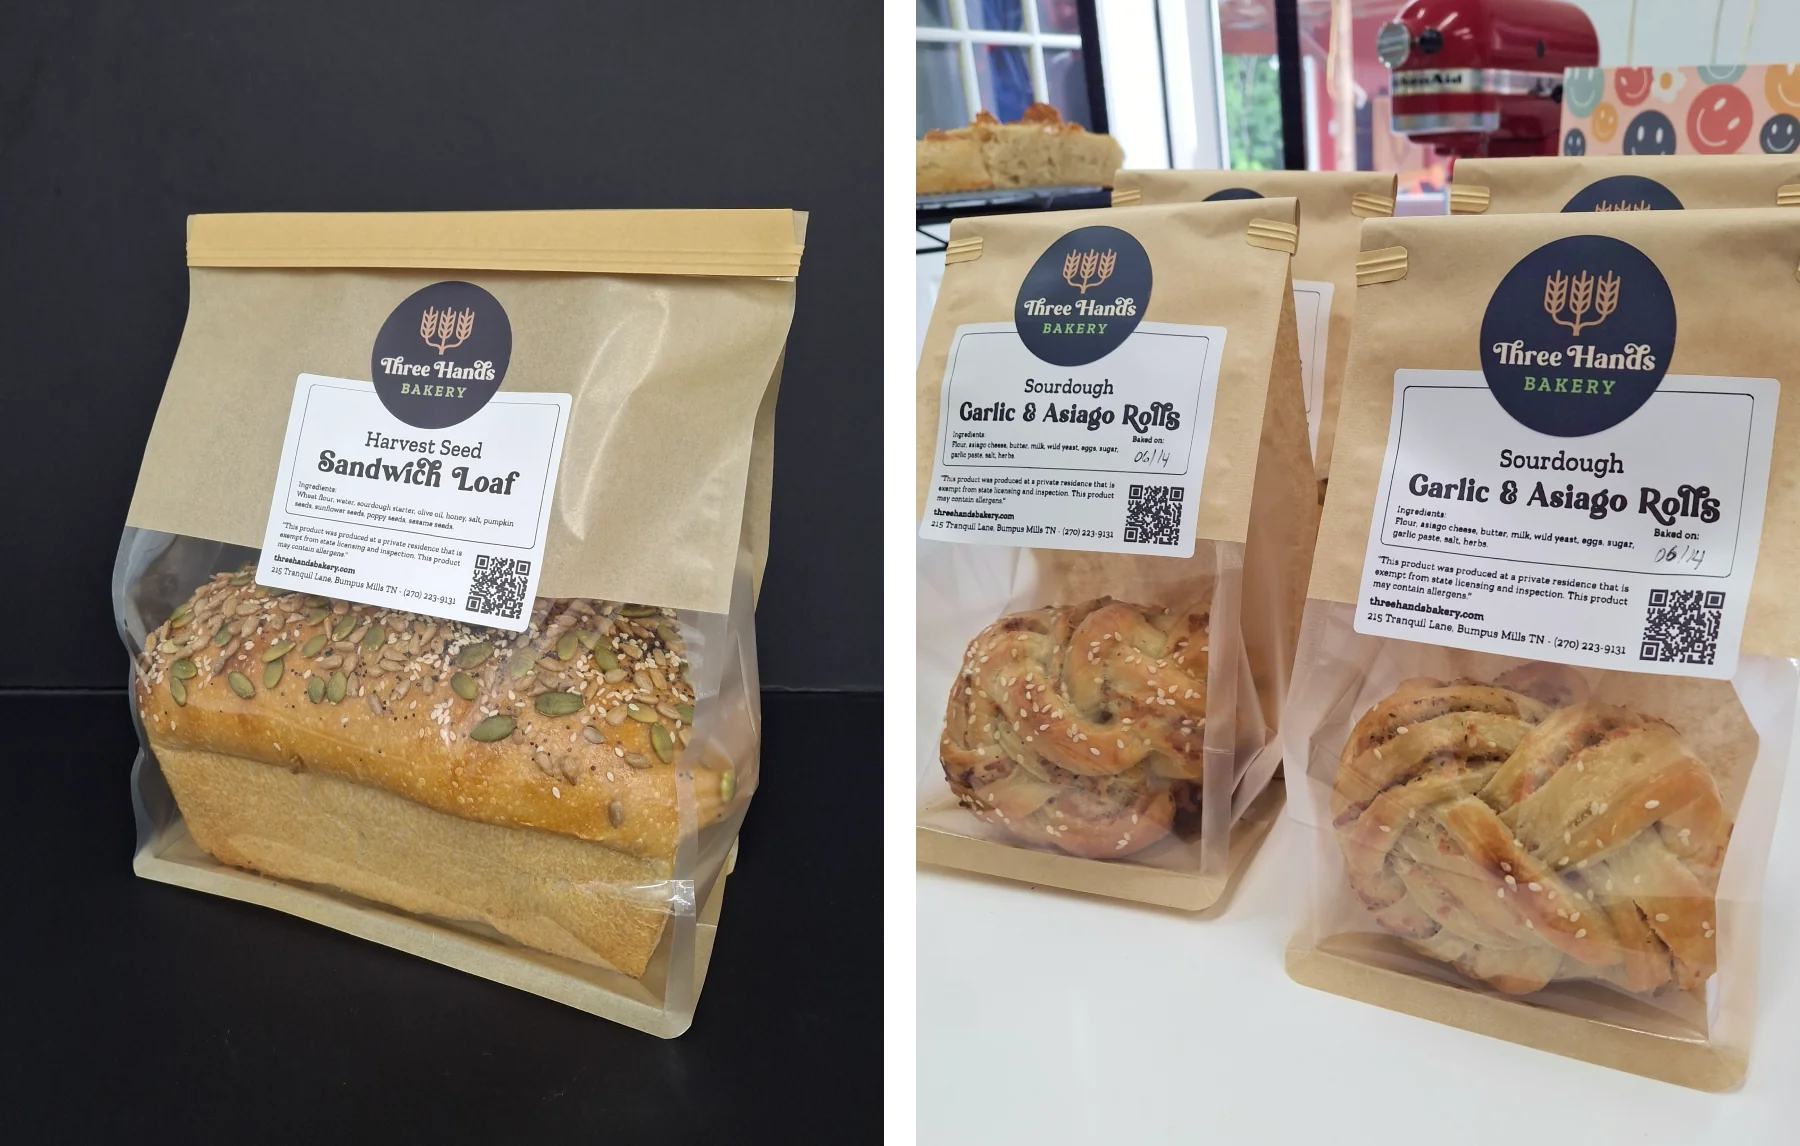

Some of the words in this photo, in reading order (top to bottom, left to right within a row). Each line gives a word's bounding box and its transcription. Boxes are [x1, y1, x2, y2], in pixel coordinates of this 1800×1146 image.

[1024, 298, 1072, 316] Three
[1075, 297, 1137, 317] Hands
[1042, 323, 1108, 335] BAKERY
[1492, 340, 1562, 366] Three
[1566, 343, 1656, 370] Hands
[380, 356, 431, 377] Three
[433, 360, 496, 381] Hands
[400, 383, 467, 399] BAKERY
[1023, 377, 1114, 399] Sourdough
[1523, 376, 1616, 395] BAKERY
[959, 401, 1016, 422] Garlic
[1022, 402, 1037, 423] &
[1041, 402, 1116, 432] Asiago
[1121, 401, 1181, 435] Rolls
[364, 430, 436, 455] Harvest
[439, 439, 483, 460] Seed
[1131, 435, 1153, 444] Baked
[317, 449, 443, 488] Sandwich
[451, 466, 521, 496] Loaf
[1499, 448, 1625, 479] Sourdough
[956, 475, 981, 485] product
[1035, 479, 1060, 487] private
[1021, 487, 1035, 496] and
[1071, 489, 1087, 498] This
[1086, 490, 1115, 500] product
[1408, 473, 1490, 503] Garlic
[1499, 479, 1519, 505] &
[1525, 481, 1628, 521] Asiago
[1637, 483, 1721, 527] Rolls
[933, 507, 1015, 521] threehandsbakery.com
[298, 525, 325, 535] product
[381, 539, 407, 548] private
[930, 520, 944, 529] 215
[945, 520, 977, 532] Tranquil
[996, 523, 1025, 535] Bumpus
[1025, 525, 1044, 534] Mills
[1044, 525, 1057, 535] TN
[1062, 526, 1081, 537] (270)
[1081, 529, 1114, 539] 223-9131
[1392, 529, 1417, 539] garlic
[1419, 521, 1448, 532] asiago
[1533, 532, 1553, 542] wild
[1653, 527, 1683, 539] Baked
[273, 553, 356, 575] threehandsbakery.com
[366, 546, 380, 554] and
[417, 552, 433, 562] This
[432, 557, 461, 567] product
[270, 566, 283, 576] 215
[283, 567, 314, 580] Tranquil
[333, 575, 365, 589] Bumpus
[365, 581, 385, 592] Mills
[385, 584, 399, 594] TN
[403, 587, 423, 600] (270)
[422, 592, 456, 606] 223-9131
[1372, 580, 1392, 591] may
[1392, 583, 1425, 594] contain
[1374, 569, 1407, 581] exempt
[1407, 571, 1430, 583] from
[1431, 576, 1454, 586] state
[1454, 577, 1496, 593] licensing
[1496, 584, 1514, 594] and
[1567, 590, 1589, 602] This
[1589, 594, 1629, 606] product
[1400, 560, 1436, 571] product
[1436, 565, 1455, 574] was
[1455, 567, 1498, 579] produced
[1499, 572, 1509, 580] at
[1517, 575, 1551, 585] private
[1551, 578, 1597, 590] residence
[1599, 581, 1619, 592] that
[1620, 583, 1630, 593] is
[1369, 596, 1485, 622] threehandsbakery.com
[1367, 612, 1383, 623] 215
[1384, 613, 1427, 629] Tranquil
[1456, 623, 1499, 639] Bumpus
[1500, 629, 1526, 643] Mills
[1528, 633, 1545, 645] TN
[1553, 636, 1580, 651] (270)
[1581, 641, 1626, 656] 223-9131
